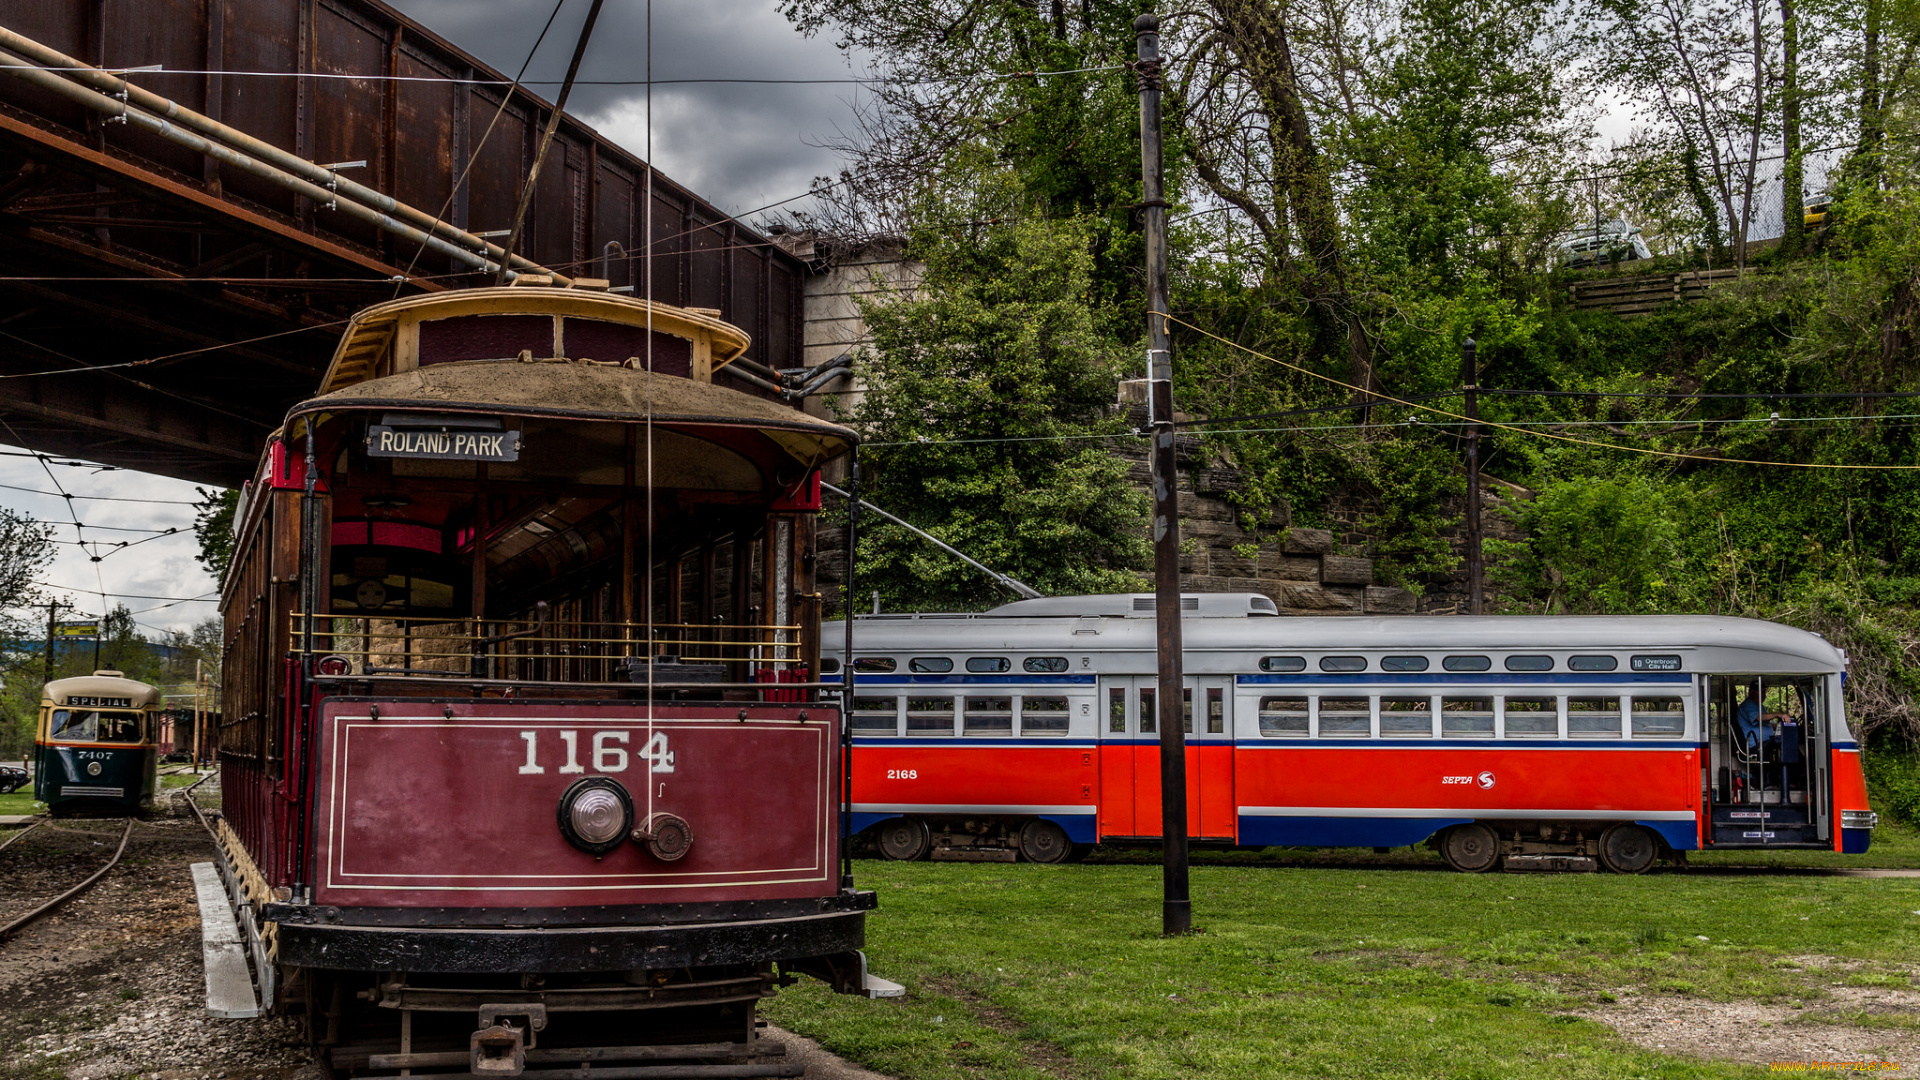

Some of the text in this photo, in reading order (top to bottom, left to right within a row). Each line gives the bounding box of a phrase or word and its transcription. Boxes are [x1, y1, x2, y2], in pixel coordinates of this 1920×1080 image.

[380, 431, 504, 457] ROLAND PARK
[1634, 660, 1642, 668] 10
[78, 751, 114, 760] 7407
[518, 730, 676, 775] 1164
[887, 769, 918, 780] 2168
[1442, 776, 1473, 784] SEPTA
